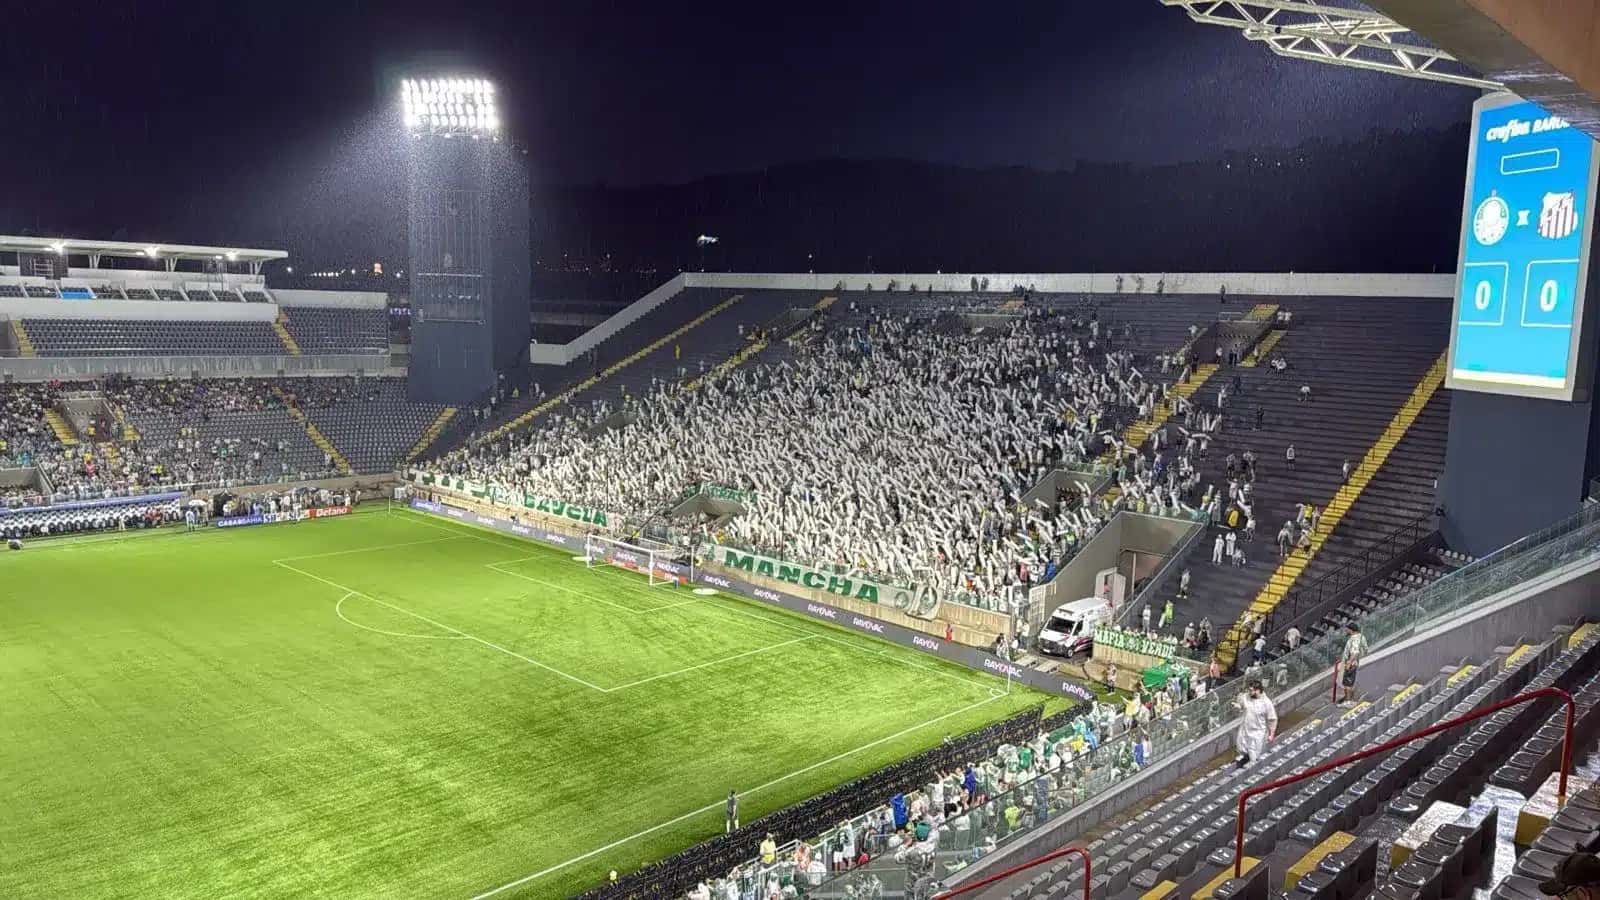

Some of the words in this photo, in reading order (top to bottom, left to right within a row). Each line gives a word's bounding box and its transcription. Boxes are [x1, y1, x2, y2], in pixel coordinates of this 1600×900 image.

[1475, 280, 1492, 311] 0
[1540, 279, 1558, 312] 0
[724, 550, 878, 604] MANCHA
[983, 658, 1023, 678] RAYOVAC
